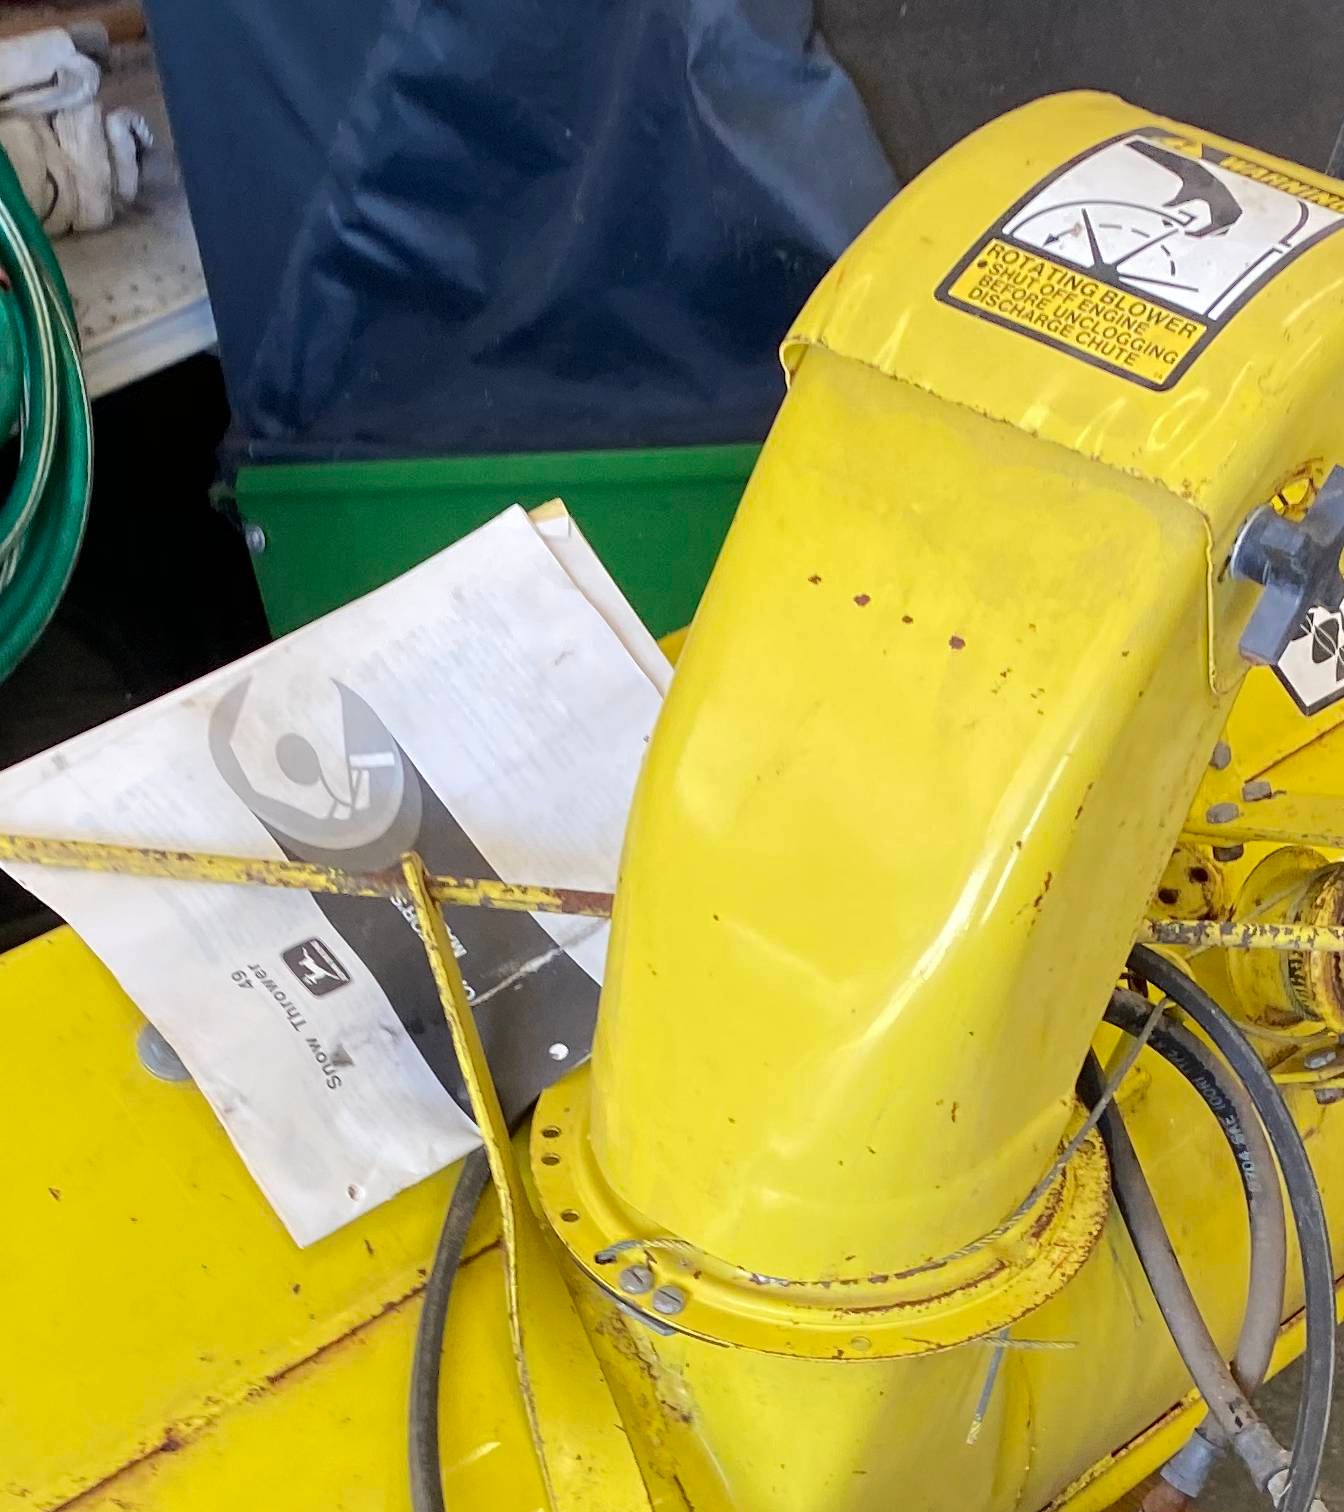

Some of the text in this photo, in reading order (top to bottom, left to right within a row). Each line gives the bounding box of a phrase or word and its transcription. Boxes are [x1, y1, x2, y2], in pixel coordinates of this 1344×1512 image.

[968, 287, 1139, 367] DISCHARGE CHUTE
[979, 275, 1178, 364] BEFORE UNCLOGGING
[987, 244, 1198, 339] ROTATING BLOWER
[989, 263, 1149, 336] SHUT OFF ENGINE
[231, 969, 254, 990] 49
[247, 963, 307, 1033] Thrower
[305, 1037, 342, 1090] Snow
